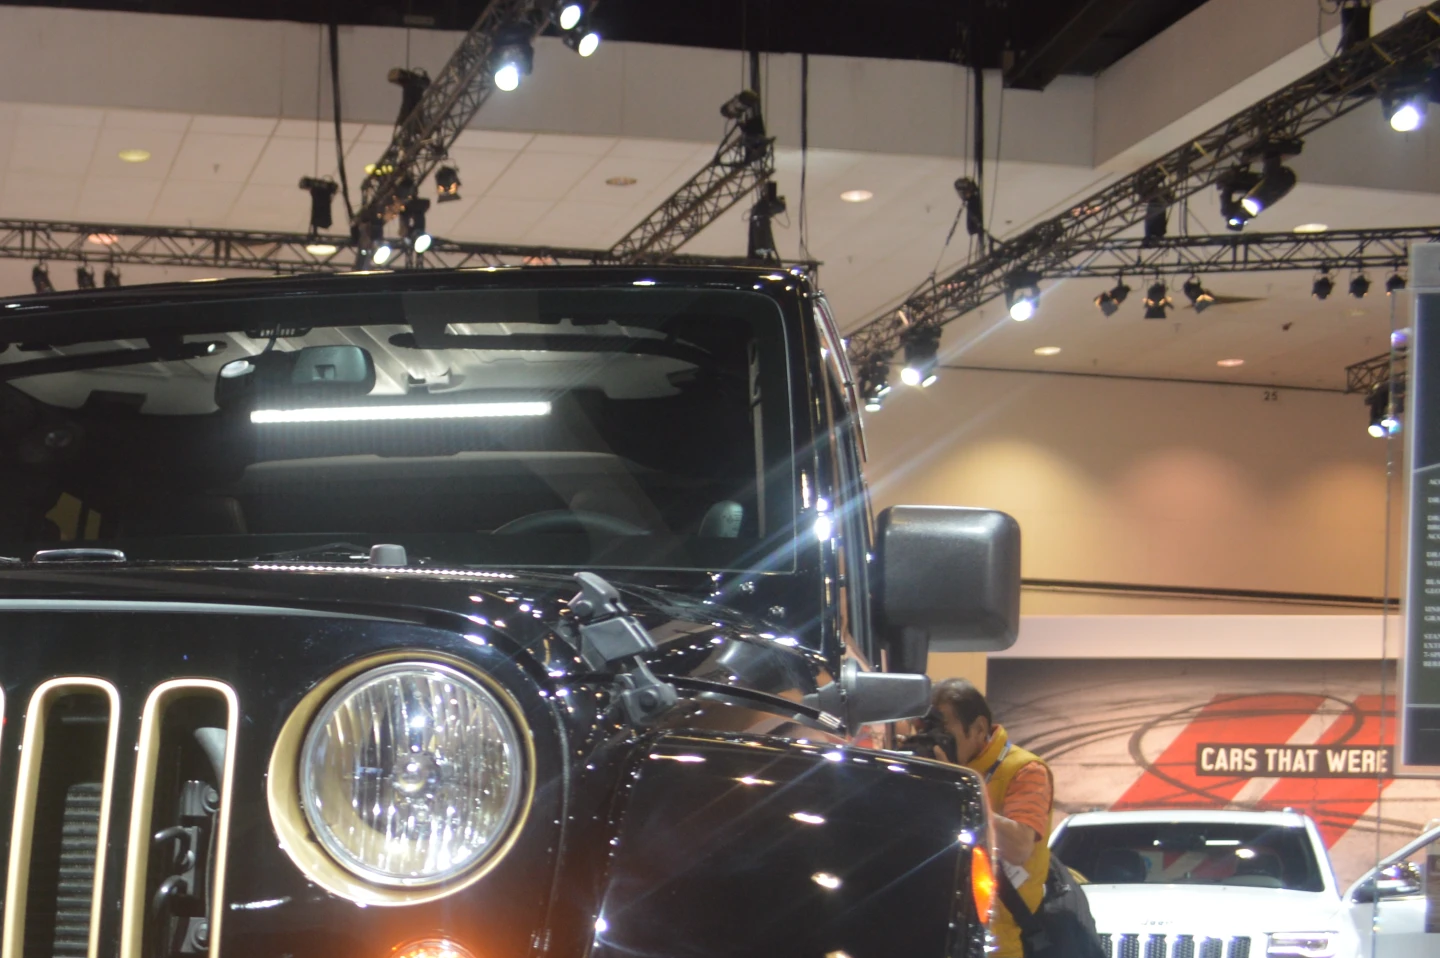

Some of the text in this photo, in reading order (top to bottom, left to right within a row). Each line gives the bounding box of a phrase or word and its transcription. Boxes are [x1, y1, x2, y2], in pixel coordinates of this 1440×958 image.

[1264, 391, 1278, 402] 25
[1201, 747, 1389, 774] CARS THAT WERE
